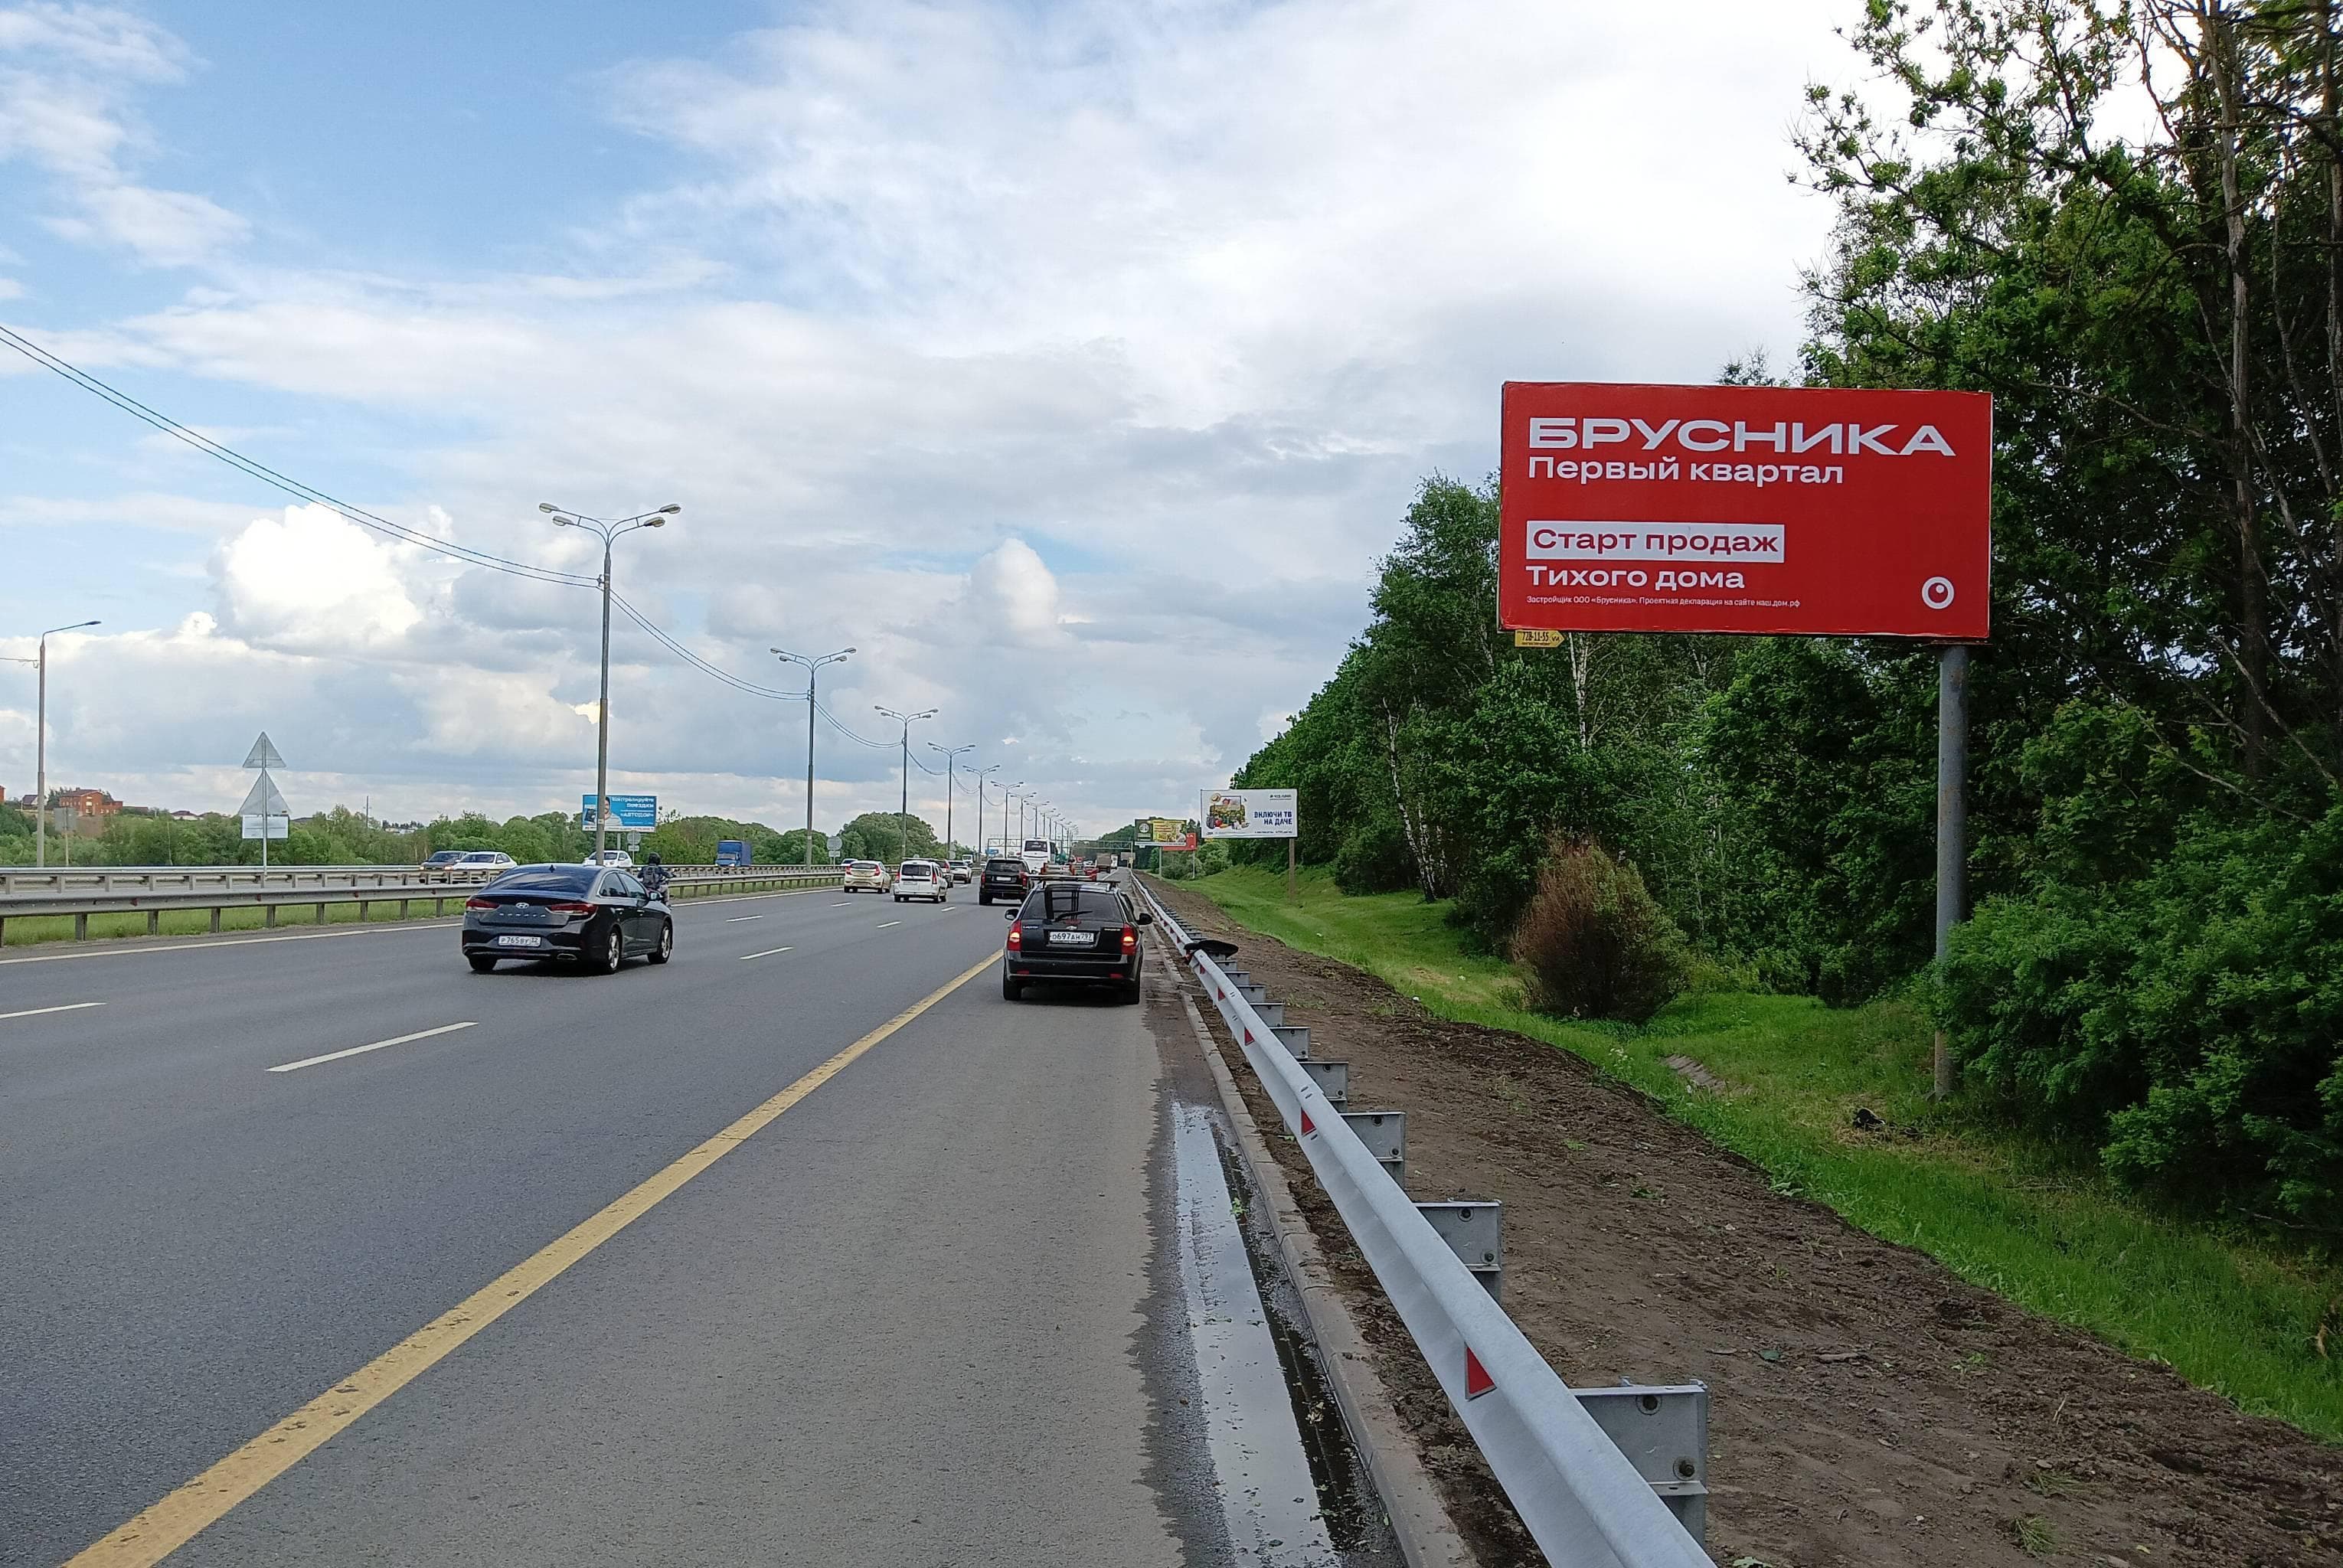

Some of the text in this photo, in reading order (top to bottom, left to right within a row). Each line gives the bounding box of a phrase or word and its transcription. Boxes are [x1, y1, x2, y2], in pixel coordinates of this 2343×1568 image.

[1529, 418, 1956, 456] БРУСНИКА
[1529, 456, 1843, 488] Первый квартал
[1533, 528, 1779, 556] Старт продаж
[1525, 566, 1745, 591] Тихого дома
[1527, 596, 1572, 604] Застройщик
[1639, 597, 1678, 606] Проектная
[1679, 598, 1723, 606] декларация
